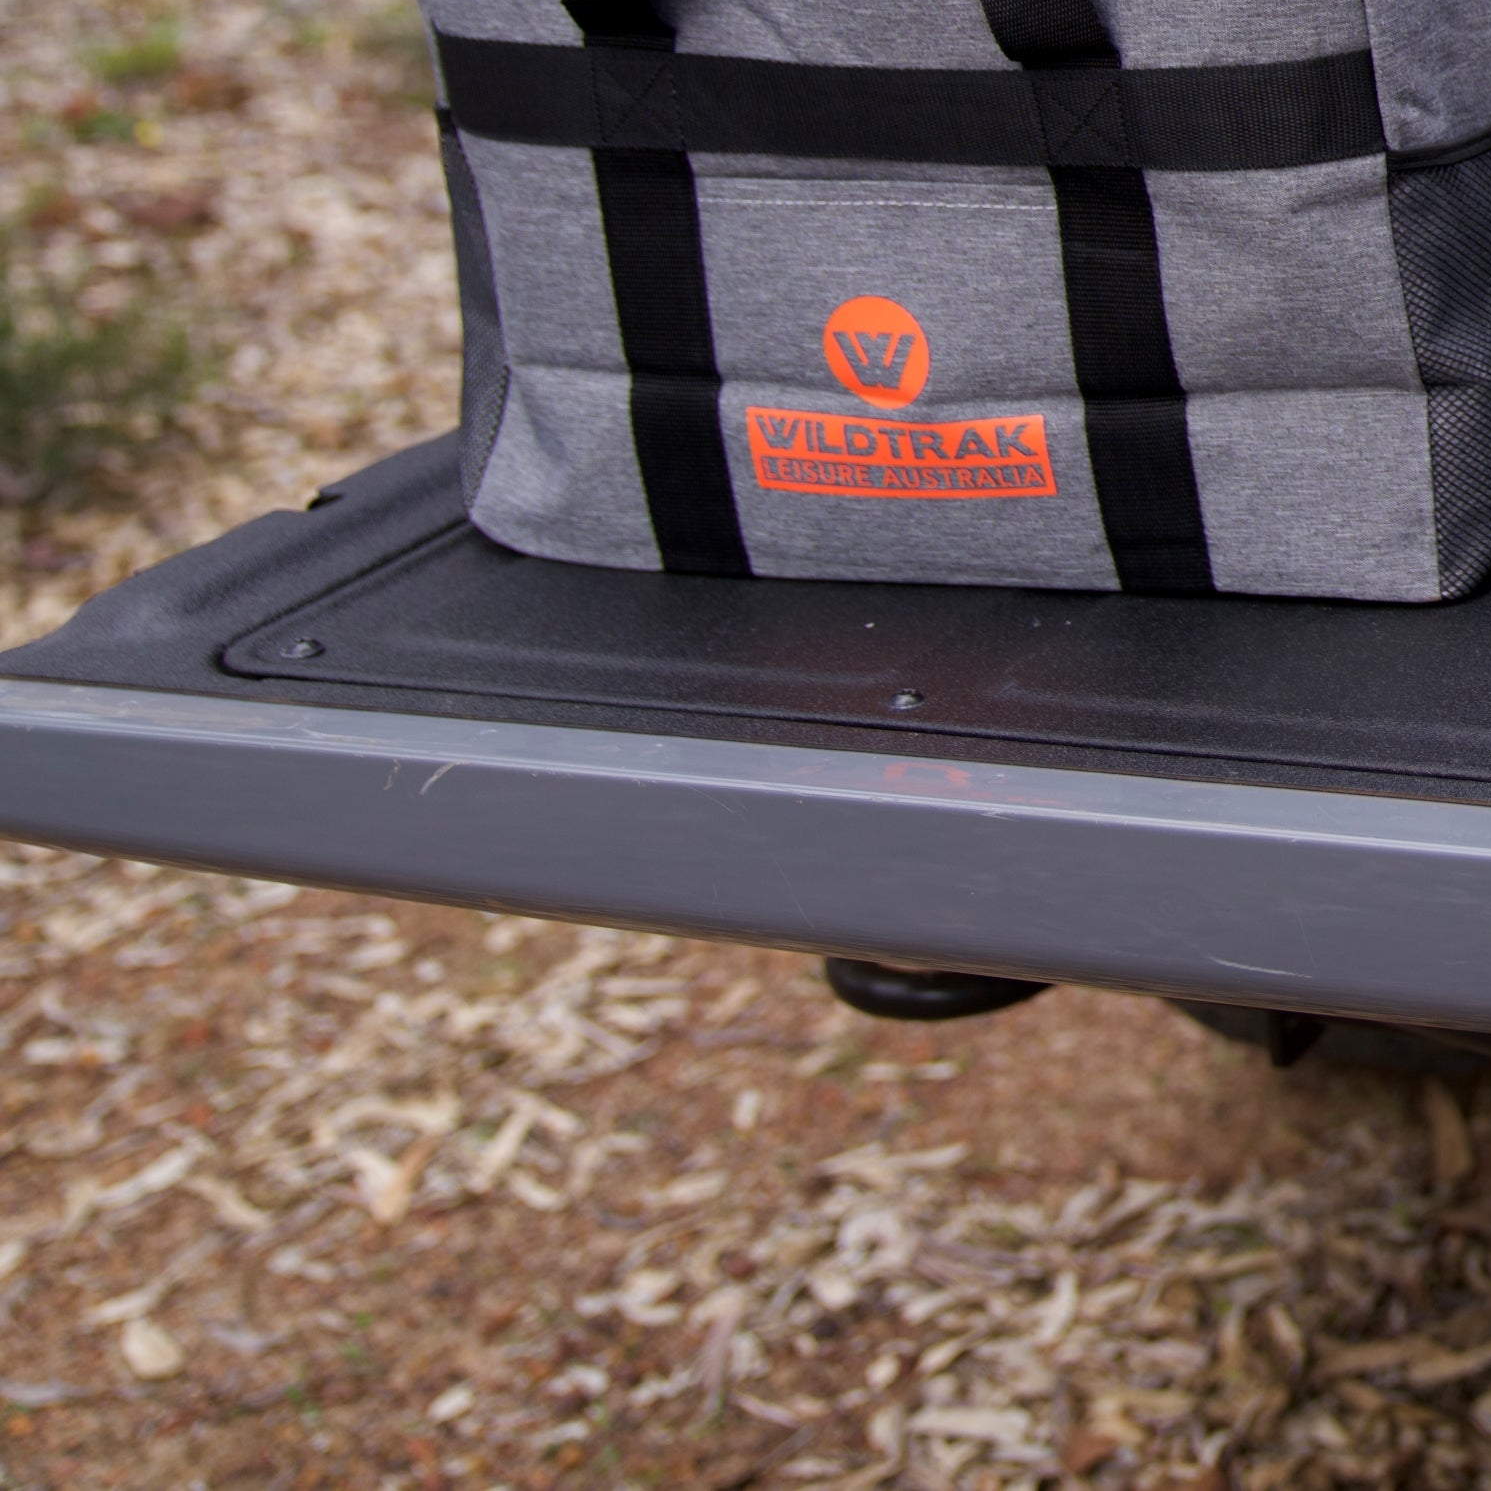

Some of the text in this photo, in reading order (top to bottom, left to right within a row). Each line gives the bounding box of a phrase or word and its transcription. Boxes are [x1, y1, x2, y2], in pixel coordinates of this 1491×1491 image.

[755, 414, 1038, 460] WILDTRAK
[762, 458, 1047, 489] LEISURE AUSTRALIA
